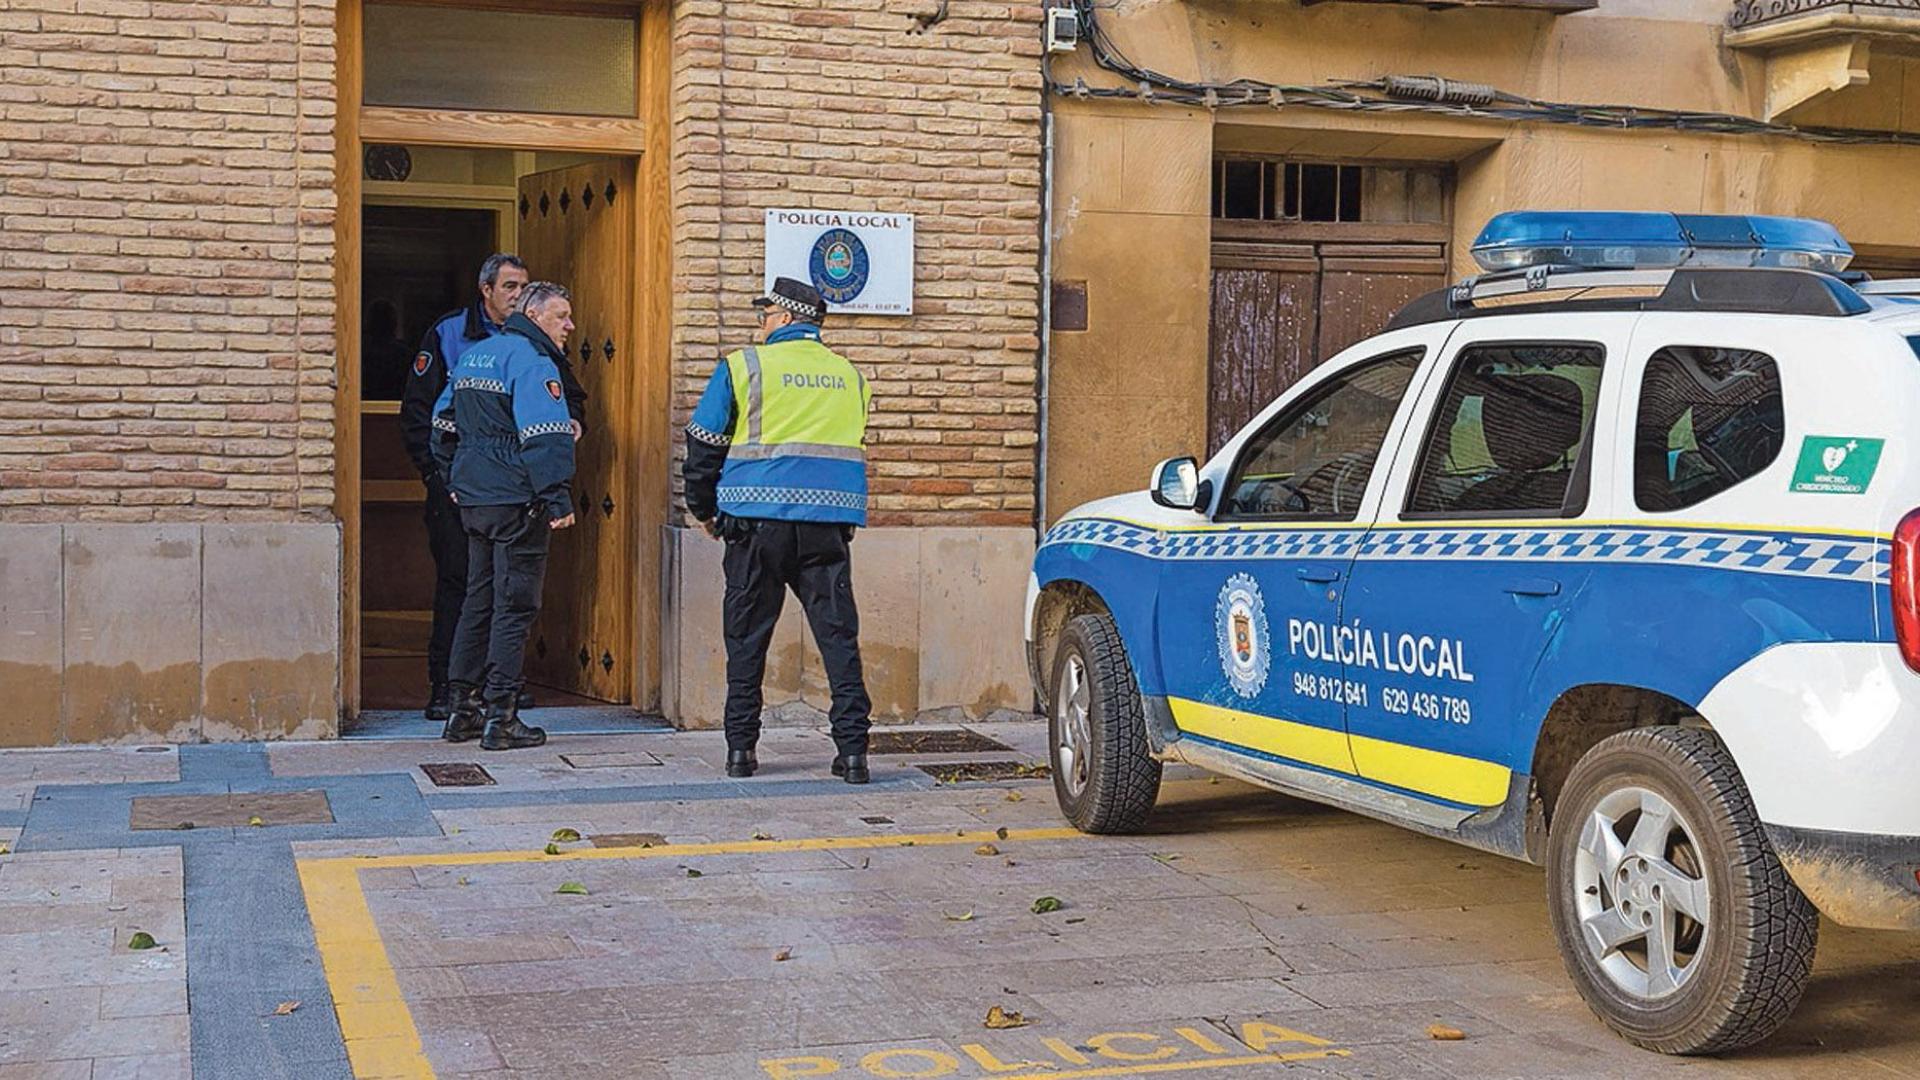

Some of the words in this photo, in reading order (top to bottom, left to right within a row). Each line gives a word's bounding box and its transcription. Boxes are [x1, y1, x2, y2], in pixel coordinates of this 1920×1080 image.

[778, 212, 842, 226] POLICIA
[848, 215, 901, 228] LOCAL
[463, 353, 496, 369] OLICIA
[782, 373, 847, 390] POLICIA
[1289, 618, 1379, 669] POLICÍA
[1383, 632, 1474, 682] LOCAL
[1294, 671, 1317, 697] 948
[1319, 676, 1343, 702] 812
[1345, 681, 1368, 707] 641
[1383, 686, 1409, 714] 629
[1412, 691, 1439, 720] 436
[1441, 697, 1470, 724] 789
[759, 1021, 1336, 1080] POLICIA
